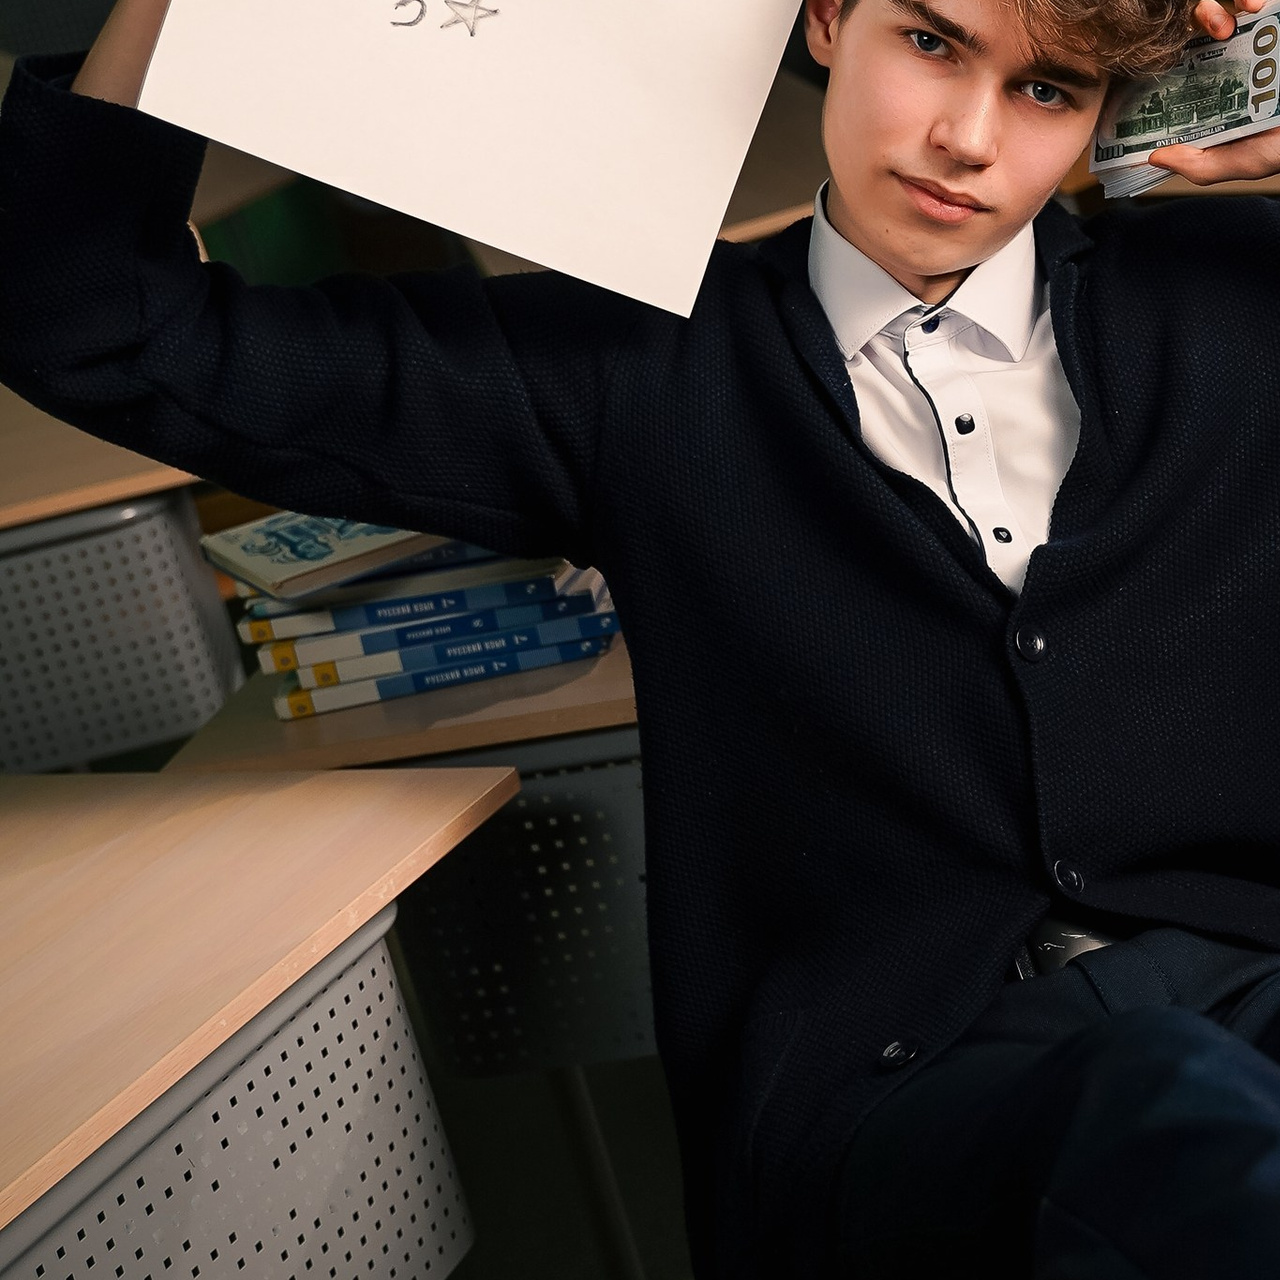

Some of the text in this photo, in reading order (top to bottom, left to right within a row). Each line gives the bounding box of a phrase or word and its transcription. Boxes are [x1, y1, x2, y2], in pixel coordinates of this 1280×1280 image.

[1251, 24, 1279, 114] 100
[1156, 124, 1226, 148] ONE HUNDRED DOLLARS
